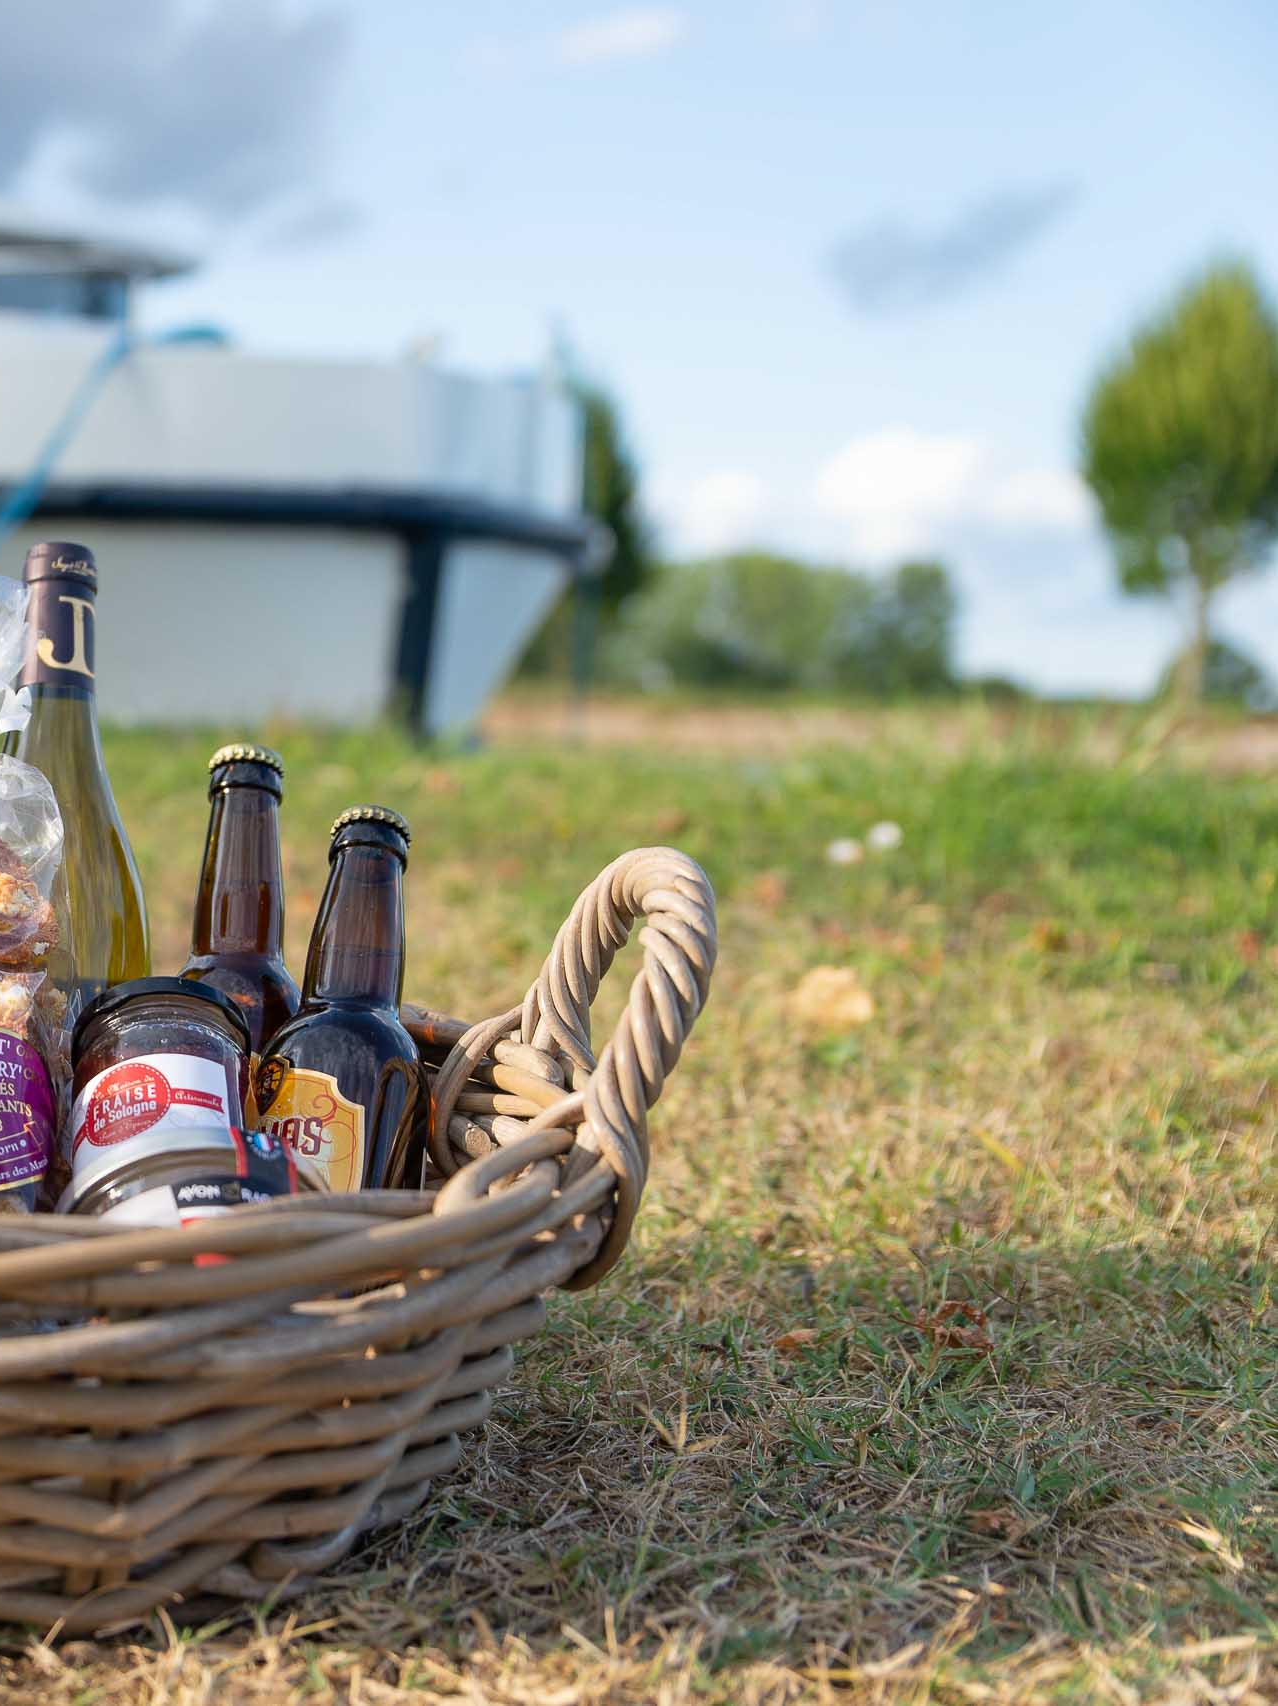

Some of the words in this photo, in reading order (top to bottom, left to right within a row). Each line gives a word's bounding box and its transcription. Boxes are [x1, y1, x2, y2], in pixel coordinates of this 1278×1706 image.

[37, 595, 96, 679] J
[93, 1083, 157, 1120] FRAISE
[93, 1117, 106, 1133] de
[108, 1100, 157, 1122] Sologne
[13, 1163, 28, 1177] des
